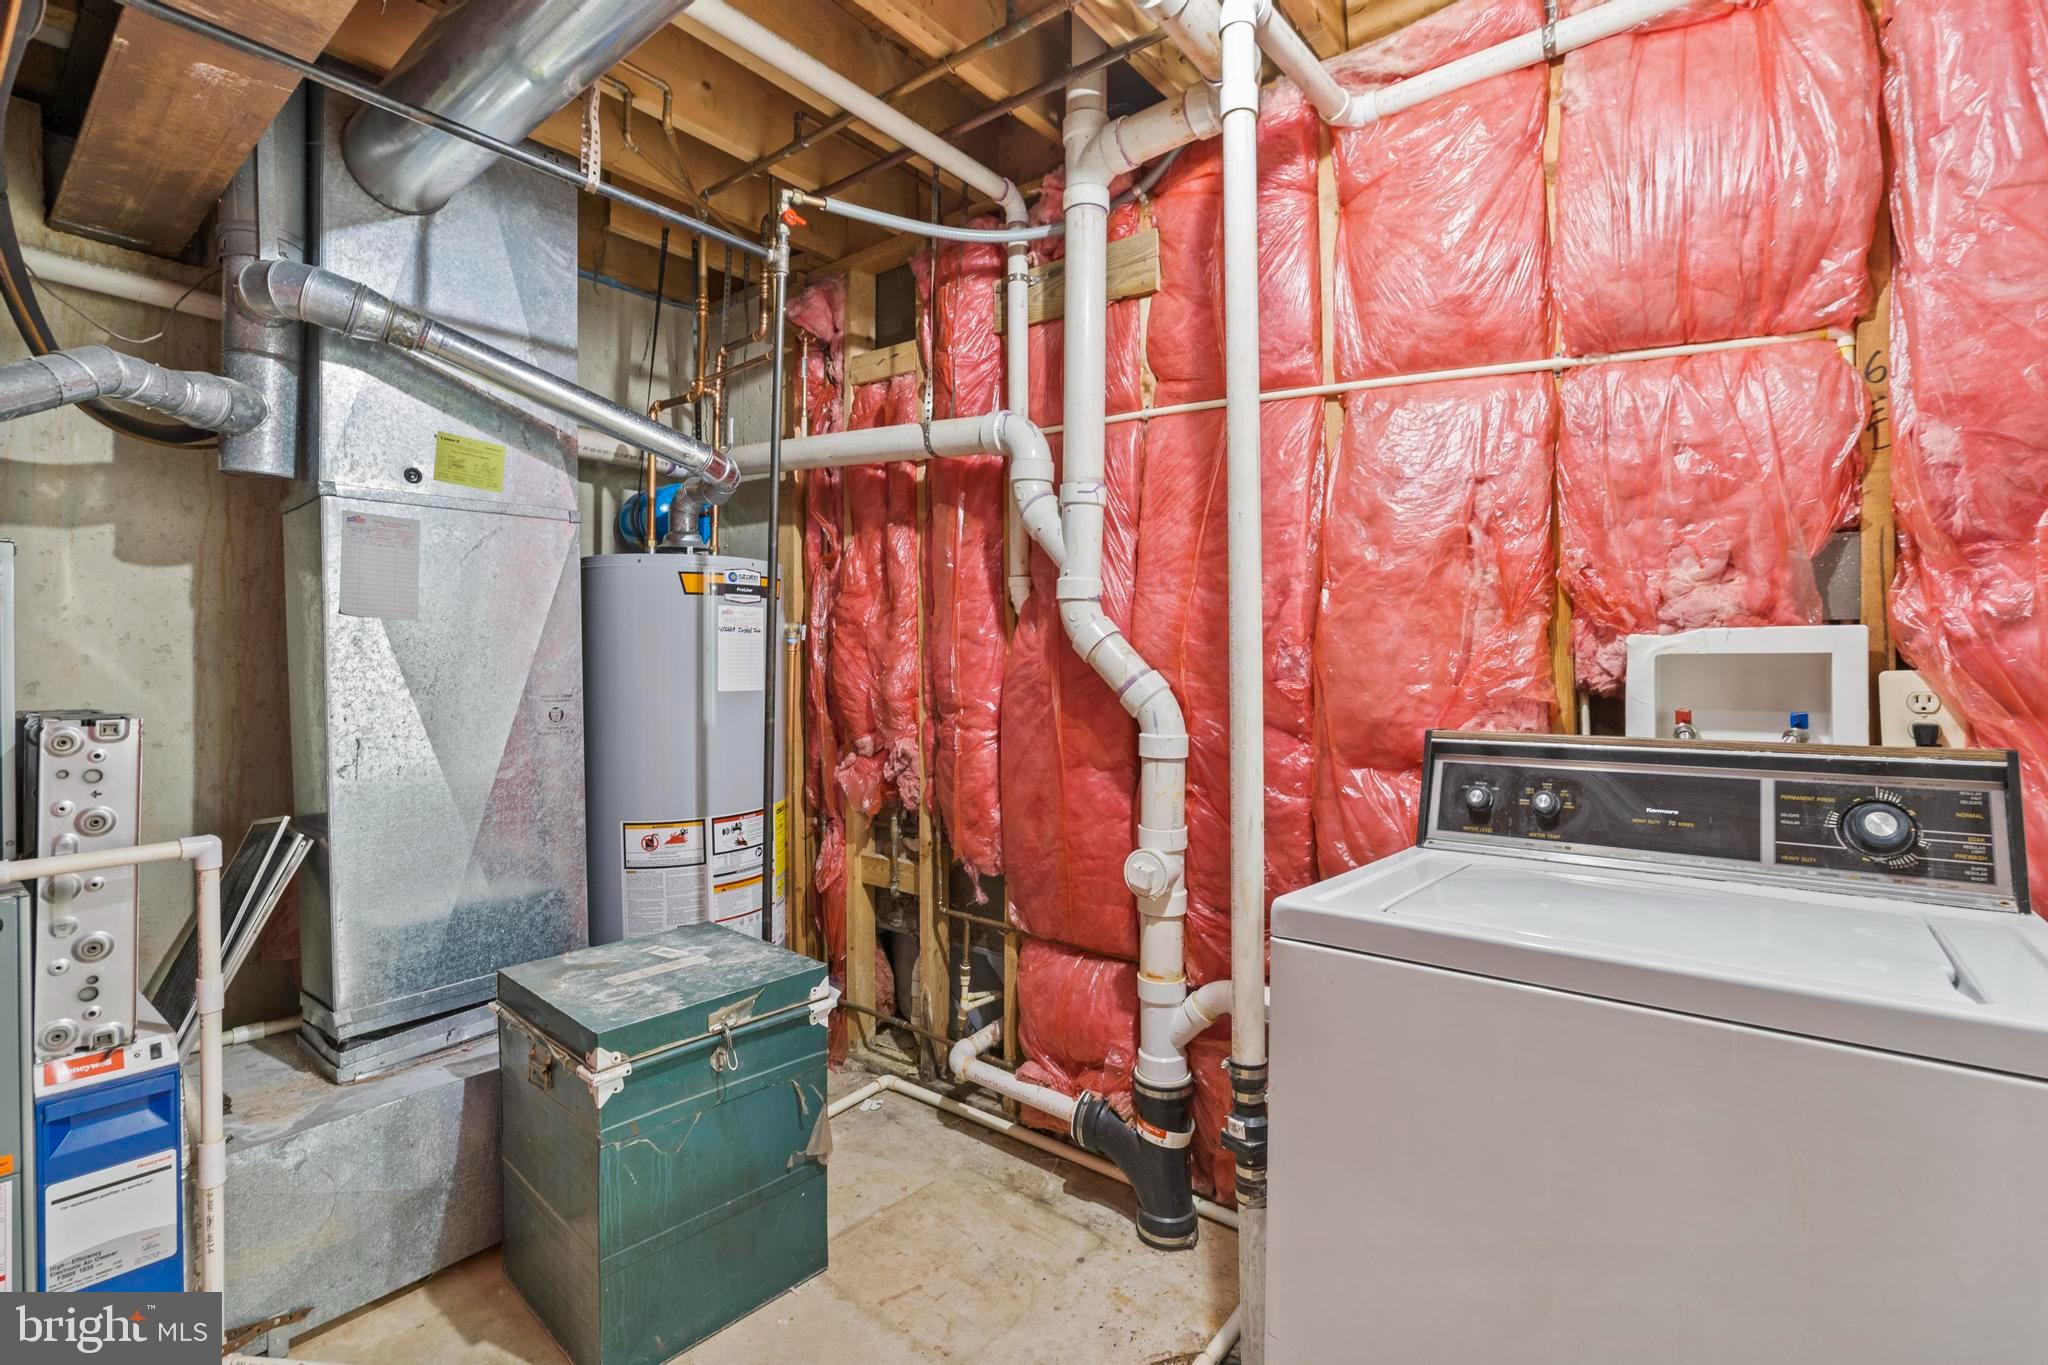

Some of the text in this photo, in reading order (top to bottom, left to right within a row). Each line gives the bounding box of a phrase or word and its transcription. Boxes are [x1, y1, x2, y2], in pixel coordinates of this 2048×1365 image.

[1864, 350, 1888, 384] 6
[737, 573, 759, 581] state
[1645, 807, 1679, 815] Kenmore
[49, 1250, 118, 1278] Electronic Air Cleaner
